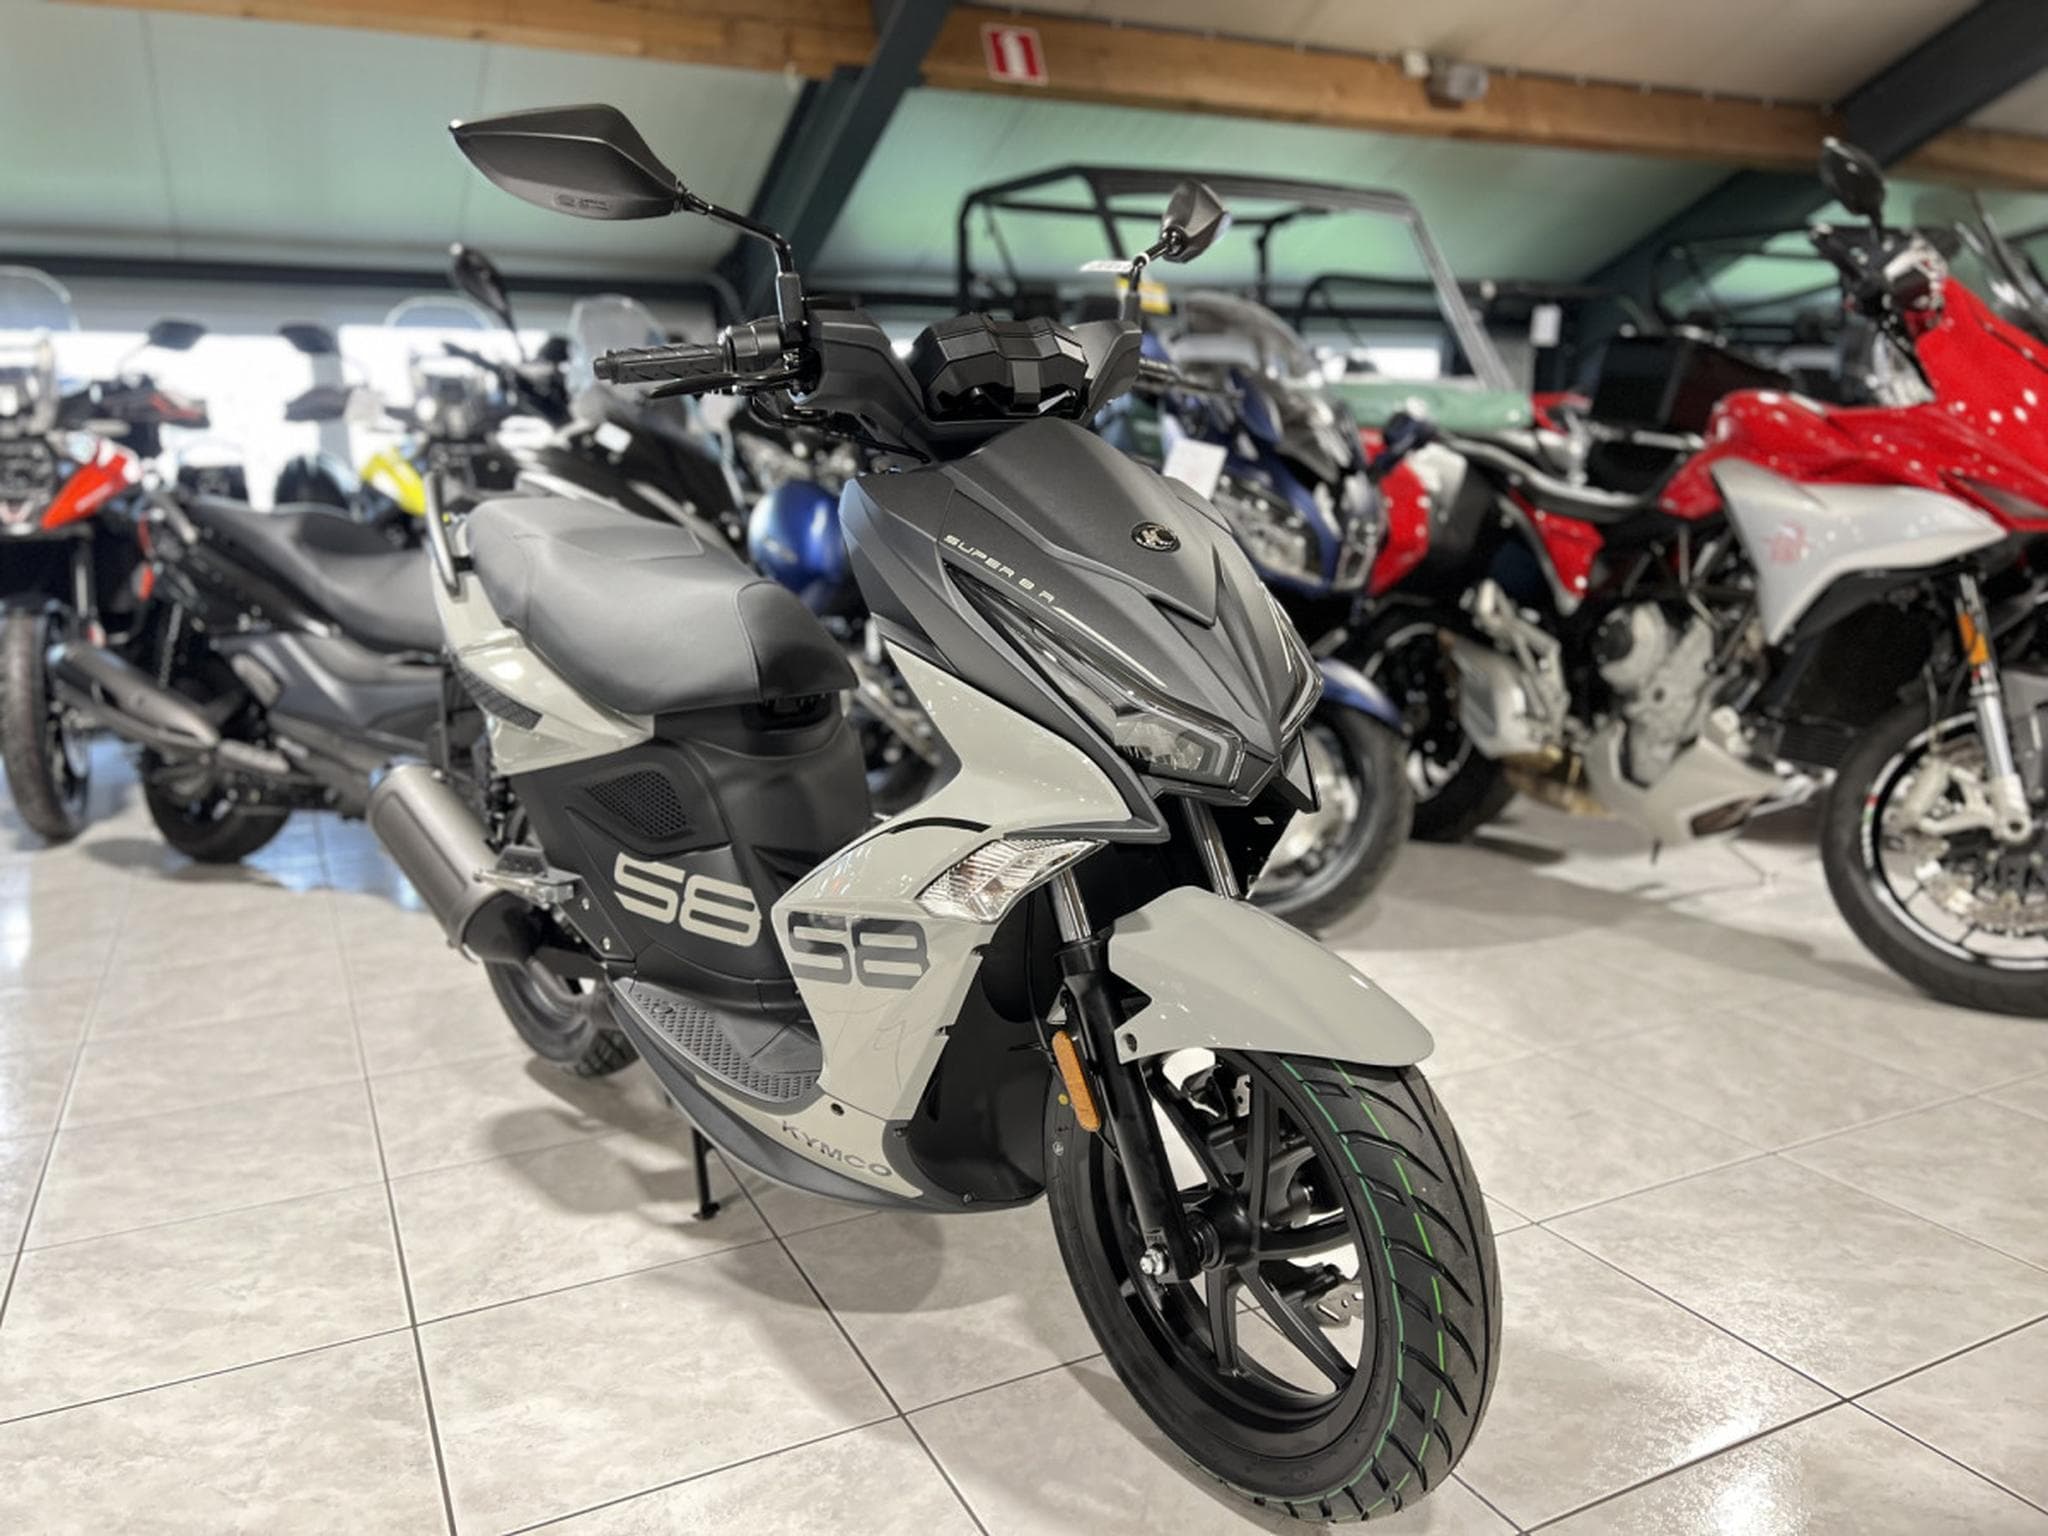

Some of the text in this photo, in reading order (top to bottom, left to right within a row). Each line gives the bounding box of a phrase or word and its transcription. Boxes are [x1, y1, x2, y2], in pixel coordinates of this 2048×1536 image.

[944, 534, 1055, 603] SUPER 8 R
[614, 852, 762, 947] S8
[788, 911, 931, 990] S8
[782, 1120, 892, 1176] KYMCO
